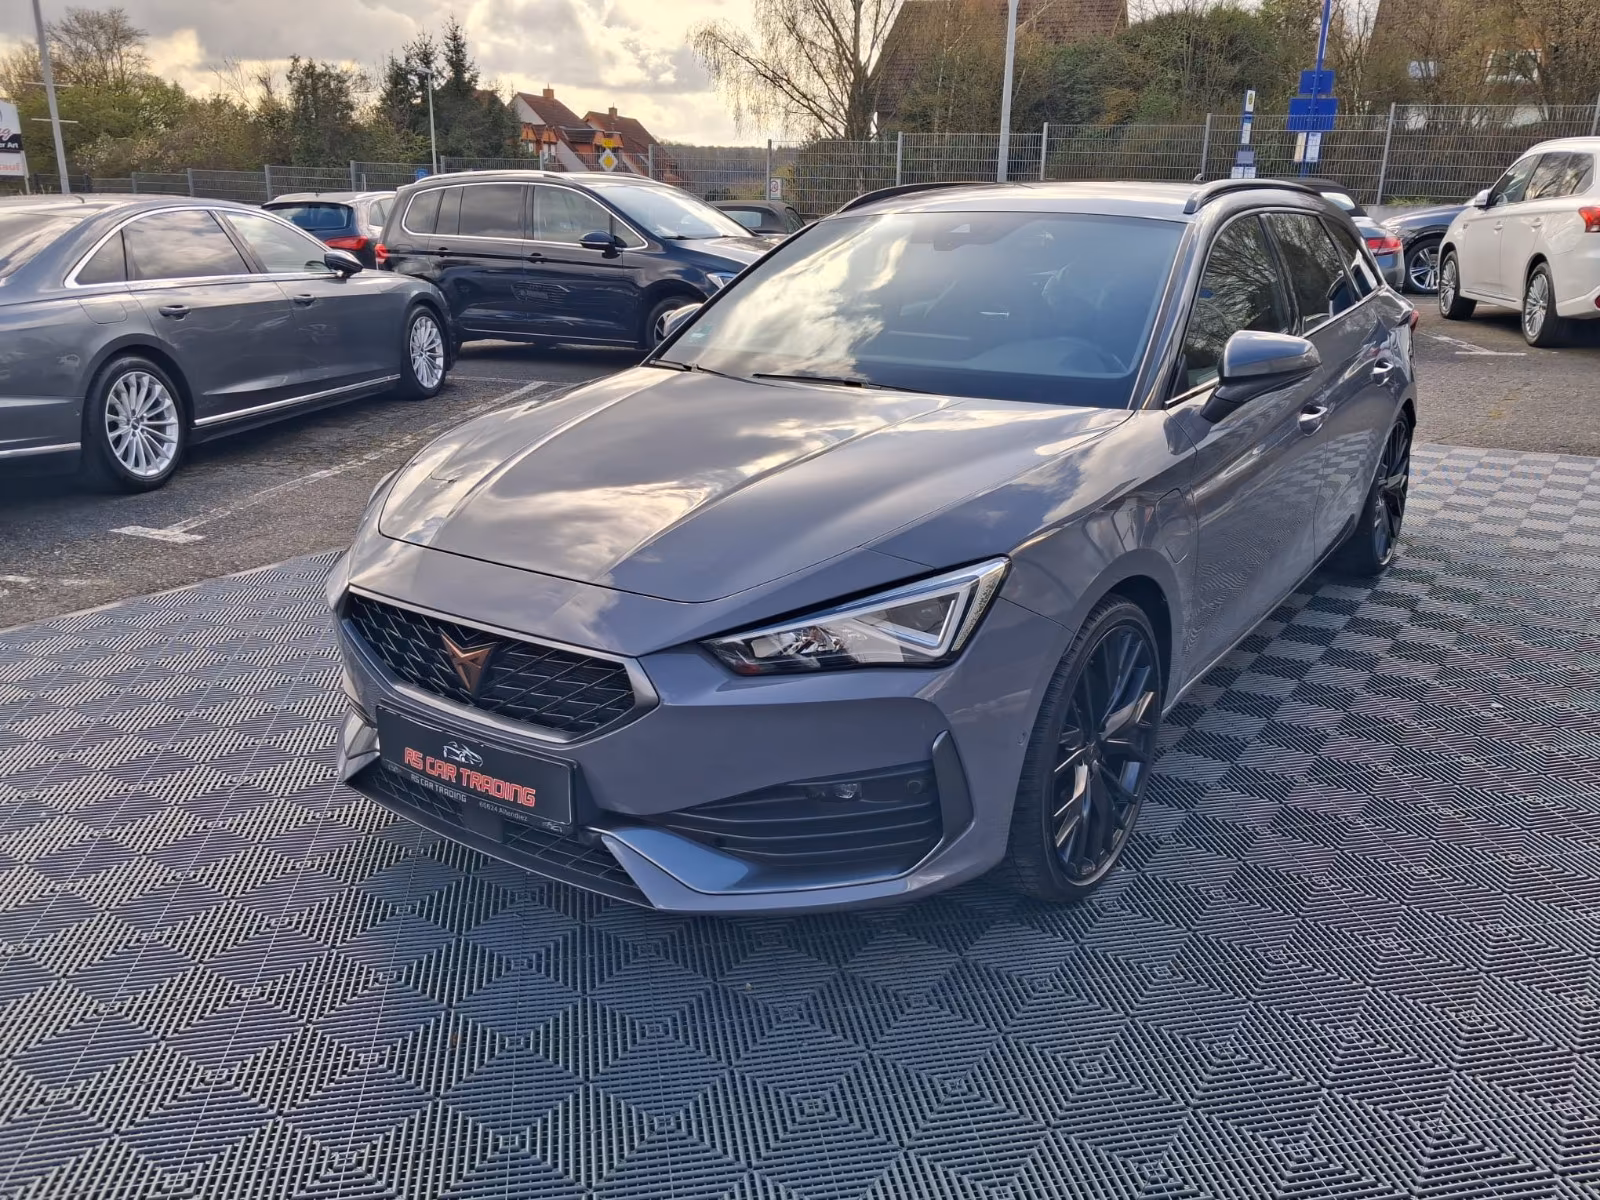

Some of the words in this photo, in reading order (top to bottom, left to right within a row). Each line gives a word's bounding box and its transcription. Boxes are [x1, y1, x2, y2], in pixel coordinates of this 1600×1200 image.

[404, 747, 423, 770] RS
[426, 756, 457, 783] CAR
[460, 767, 536, 807] TRADING
[410, 773, 420, 784] RS
[420, 778, 434, 790] CAR
[435, 784, 467, 803] TRADING
